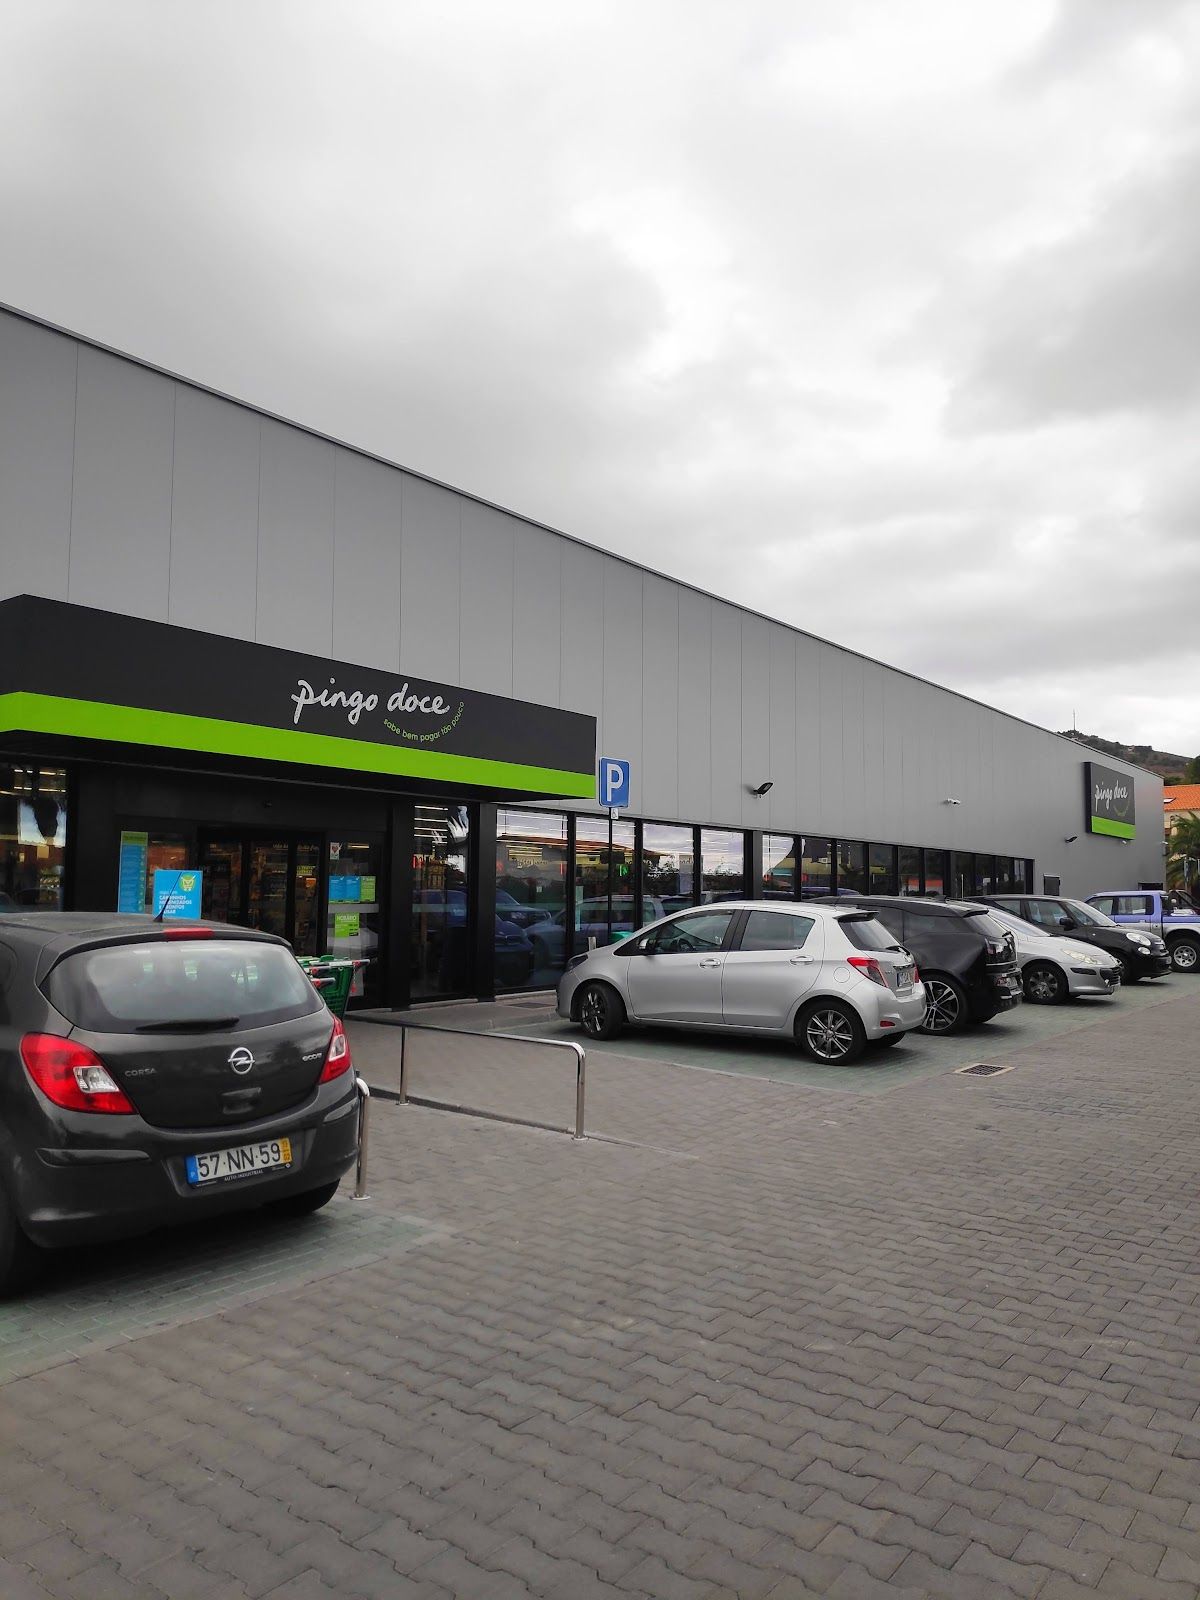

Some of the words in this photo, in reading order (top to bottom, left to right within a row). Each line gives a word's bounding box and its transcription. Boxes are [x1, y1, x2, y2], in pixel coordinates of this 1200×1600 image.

[291, 677, 379, 725] pingo
[386, 682, 451, 714] doce
[383, 718, 401, 734] sabe
[402, 729, 419, 741] bem
[420, 731, 441, 742] pagar
[440, 724, 452, 735] tão
[451, 701, 465, 727] pouco
[606, 763, 624, 801] P
[1113, 779, 1128, 799] doce
[125, 1067, 157, 1077] CORSA
